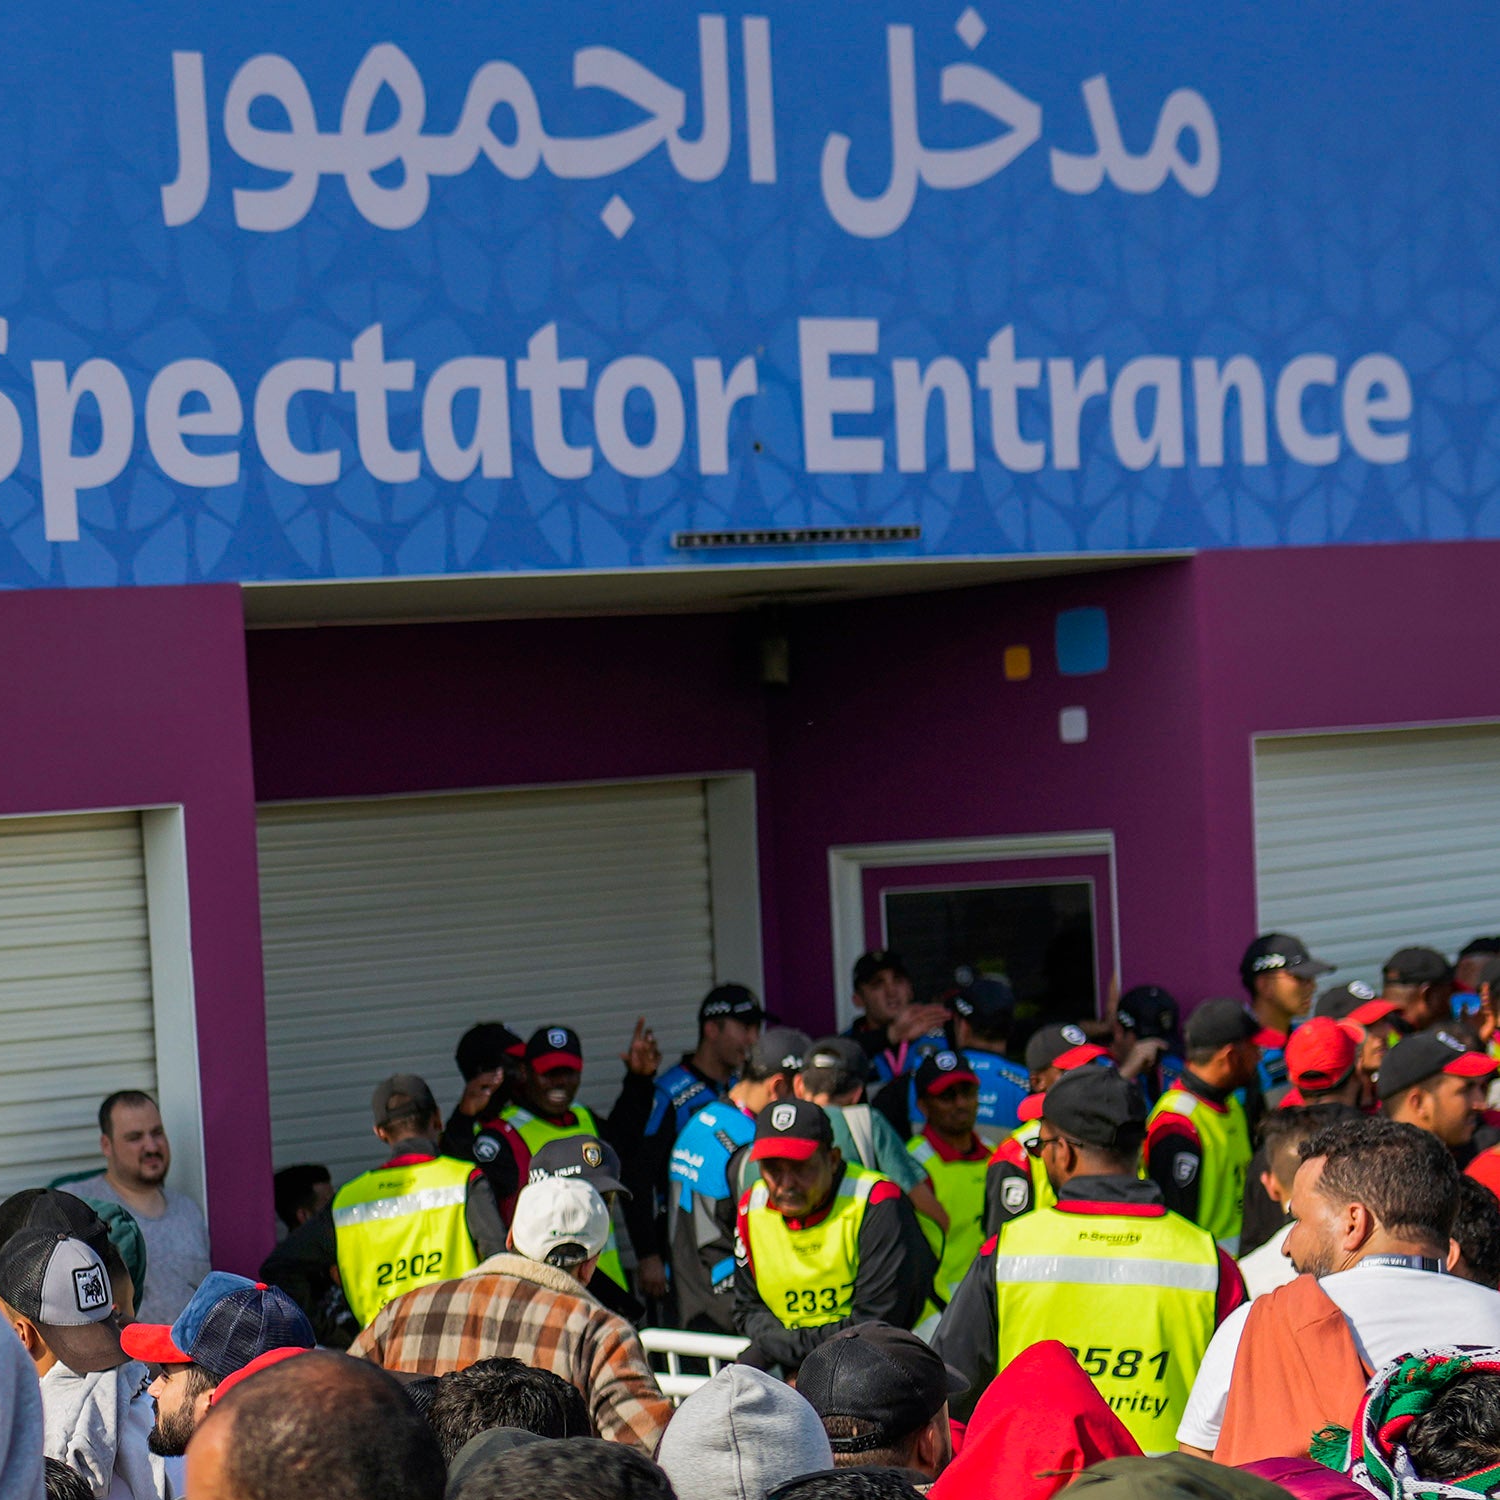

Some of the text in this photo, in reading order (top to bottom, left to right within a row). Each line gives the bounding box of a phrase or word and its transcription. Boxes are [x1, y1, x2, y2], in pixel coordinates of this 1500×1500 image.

[161, 8, 1219, 239] مدخل الجمهور
[799, 317, 1411, 474] Entrance
[376, 1251, 442, 1286] 2202
[1068, 1347, 1170, 1381] 581
